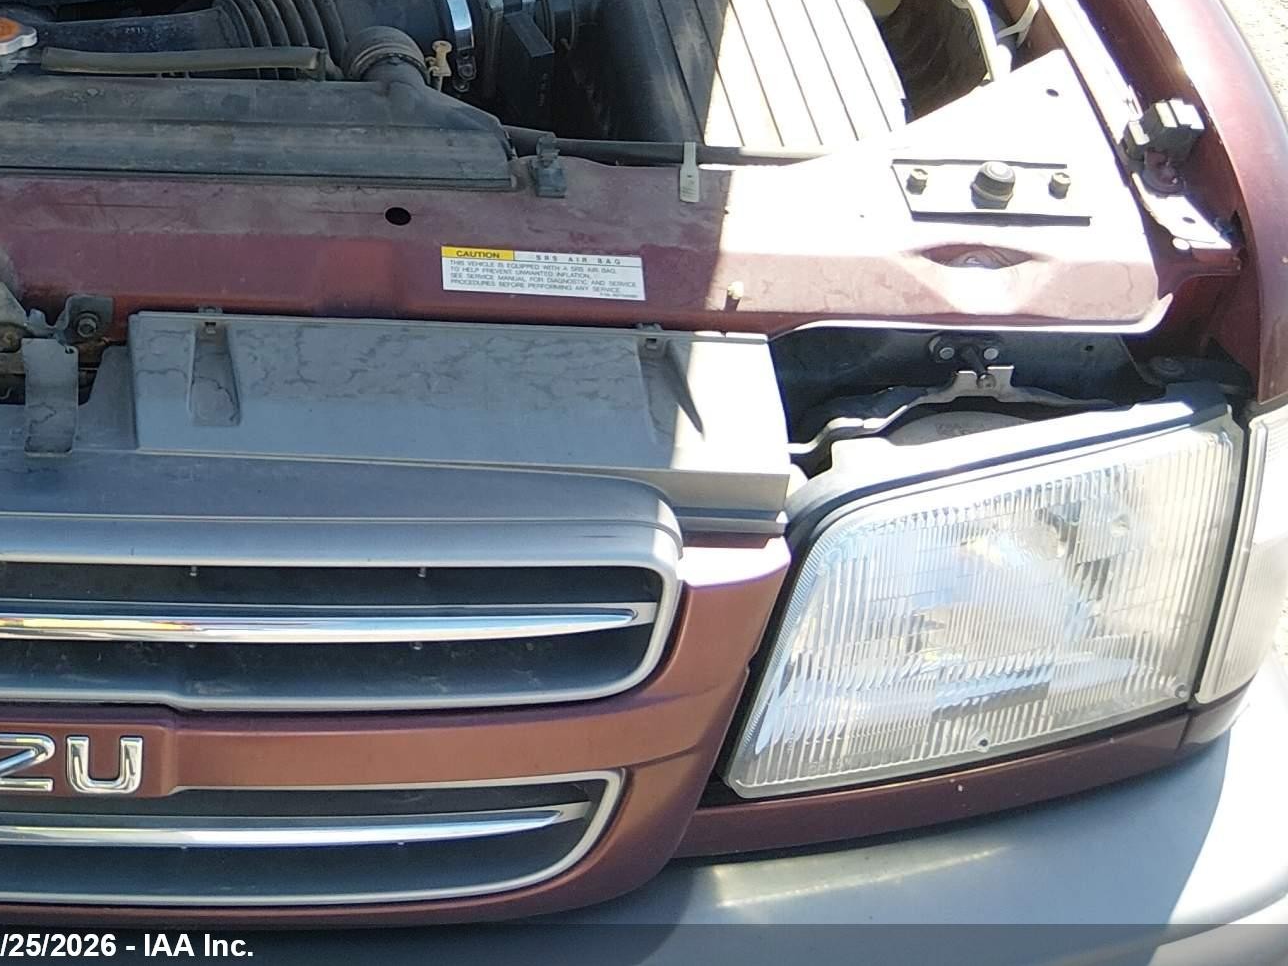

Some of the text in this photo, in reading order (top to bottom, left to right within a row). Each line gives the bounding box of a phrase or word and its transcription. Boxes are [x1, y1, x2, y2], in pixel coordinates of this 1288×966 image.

[456, 250, 500, 259] CAUTION
[535, 254, 558, 262] SRS
[568, 256, 588, 264] AIR
[468, 260, 495, 268] VEHICLE
[507, 262, 540, 270] EQUIPPED
[515, 269, 553, 277] UNWANTED
[450, 279, 496, 287] PROCEDURES
[499, 281, 525, 289] BEFORE
[528, 283, 573, 291] PERFORMING
[497, 275, 526, 283] MANUAL
[546, 277, 587, 285] DIAGNOSTIC
[608, 280, 637, 288] SERVICE
